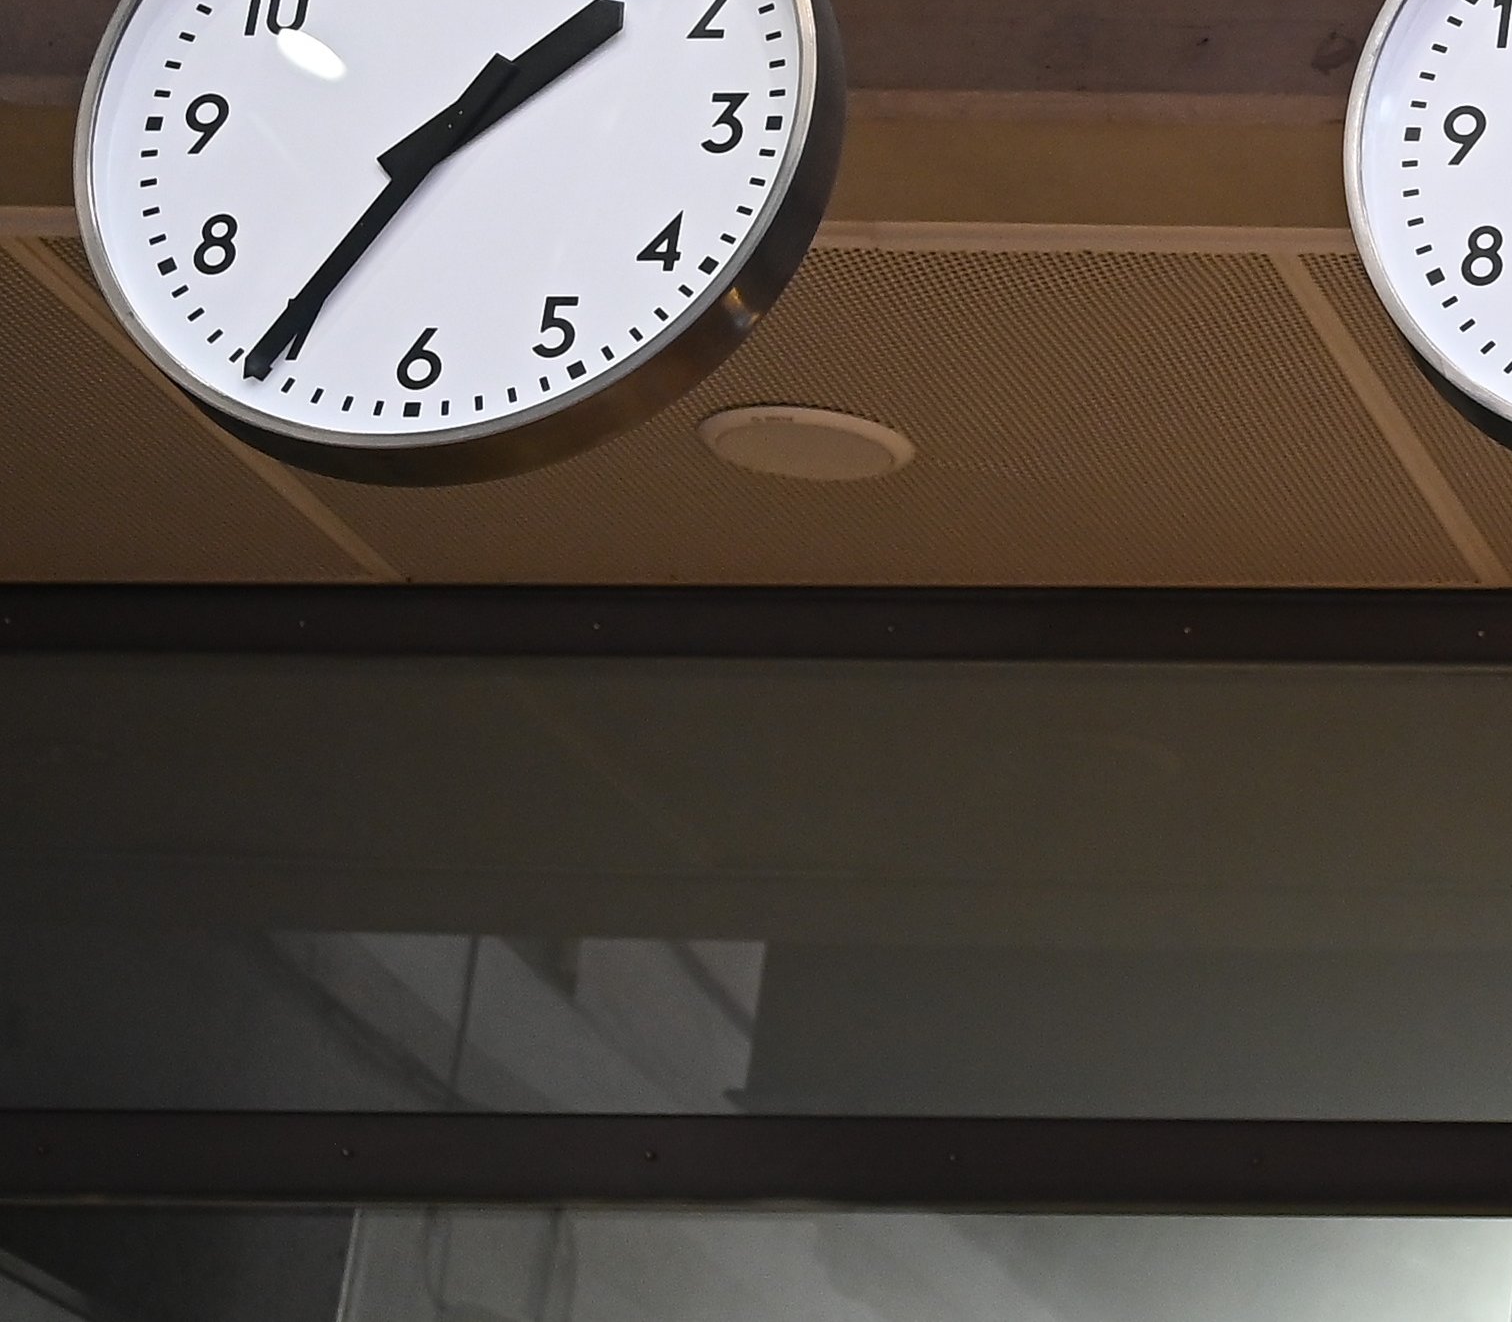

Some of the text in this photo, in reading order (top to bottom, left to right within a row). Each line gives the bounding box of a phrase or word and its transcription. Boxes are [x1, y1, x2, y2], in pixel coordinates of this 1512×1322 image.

[185, 93, 230, 155] 9
[700, 92, 750, 154] 3
[1443, 105, 1487, 166] 9
[193, 213, 238, 276] 8
[636, 210, 684, 272] 4
[1460, 225, 1503, 287] 8
[532, 296, 579, 359] 5
[396, 327, 442, 391] 6
